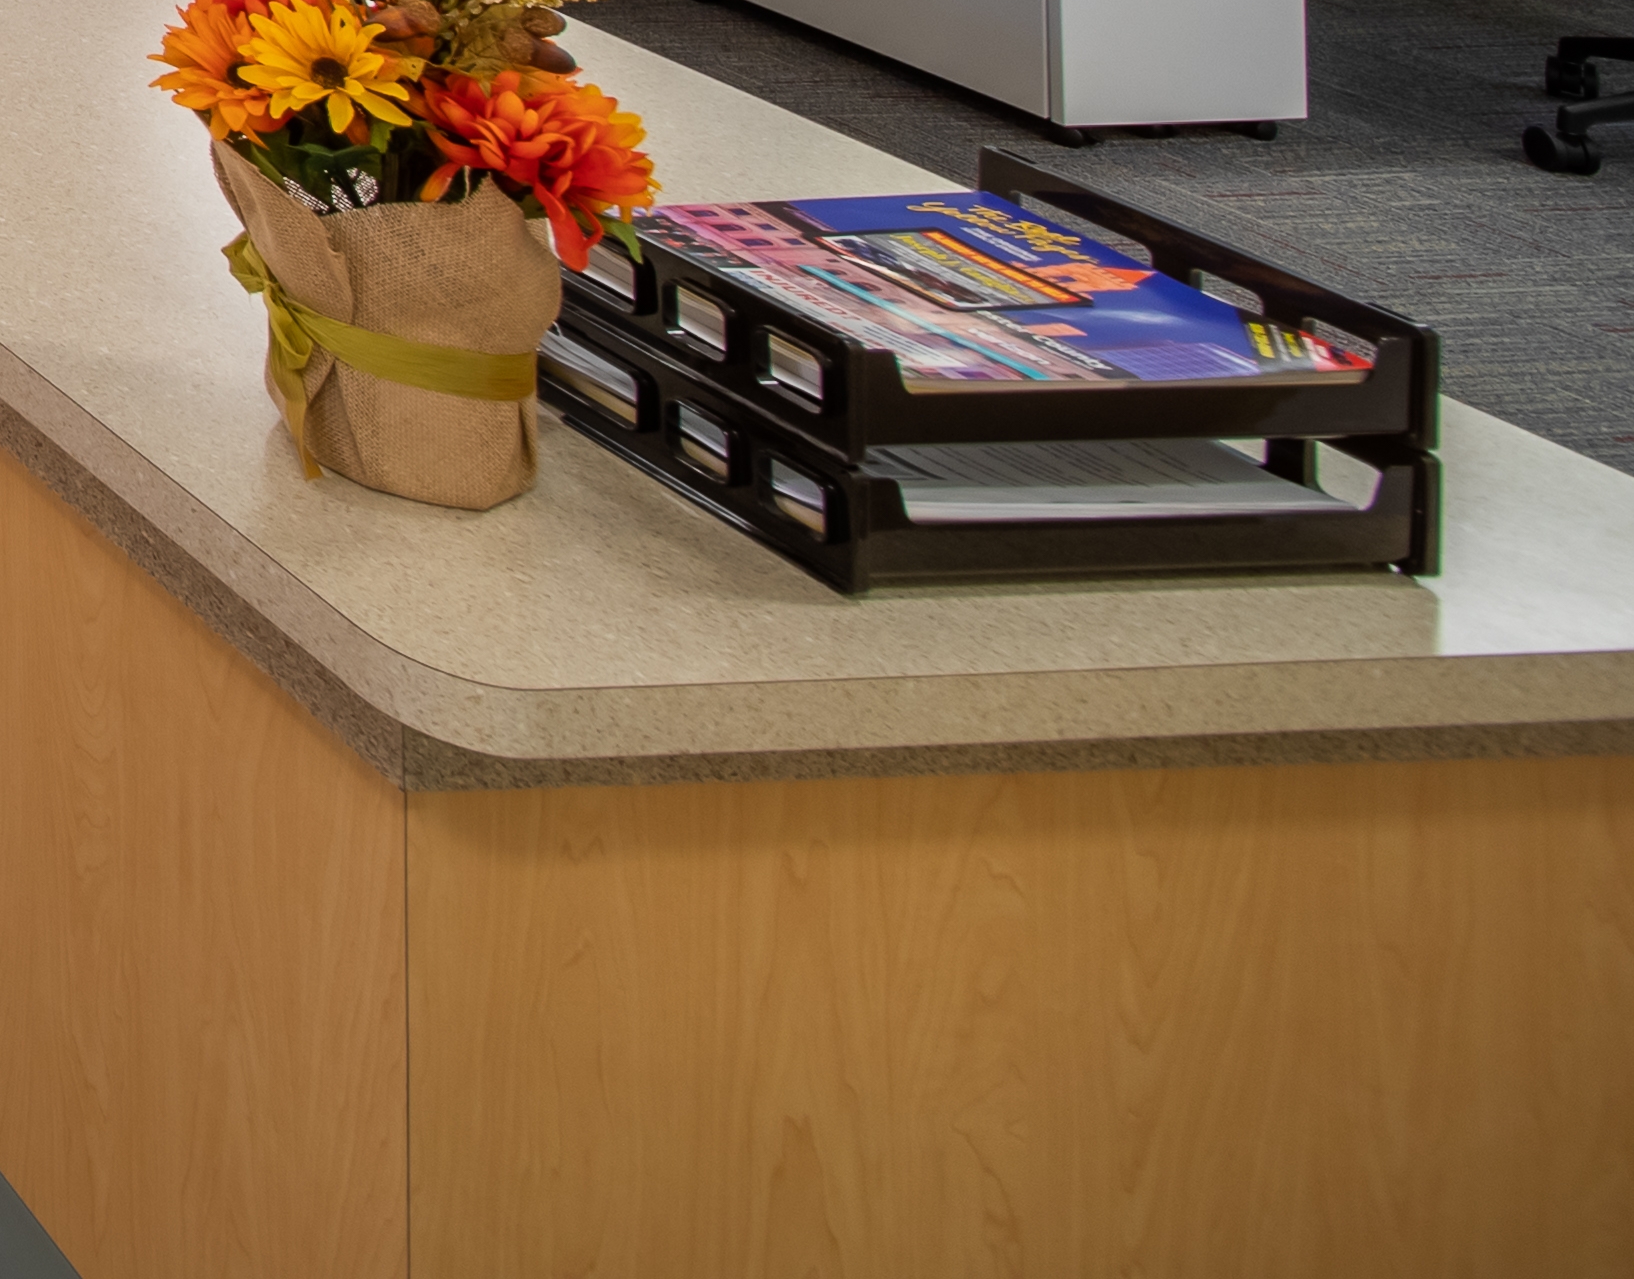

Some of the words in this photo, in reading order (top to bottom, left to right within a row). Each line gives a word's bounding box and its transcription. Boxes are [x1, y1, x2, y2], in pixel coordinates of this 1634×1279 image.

[905, 200, 1020, 235] Yellow
[1012, 234, 1100, 262] Pages
[963, 204, 1016, 222] The
[998, 220, 1081, 246] Best
[751, 270, 862, 322] INJURED?
[967, 327, 1053, 367] verizon
[1032, 333, 1114, 372] County
